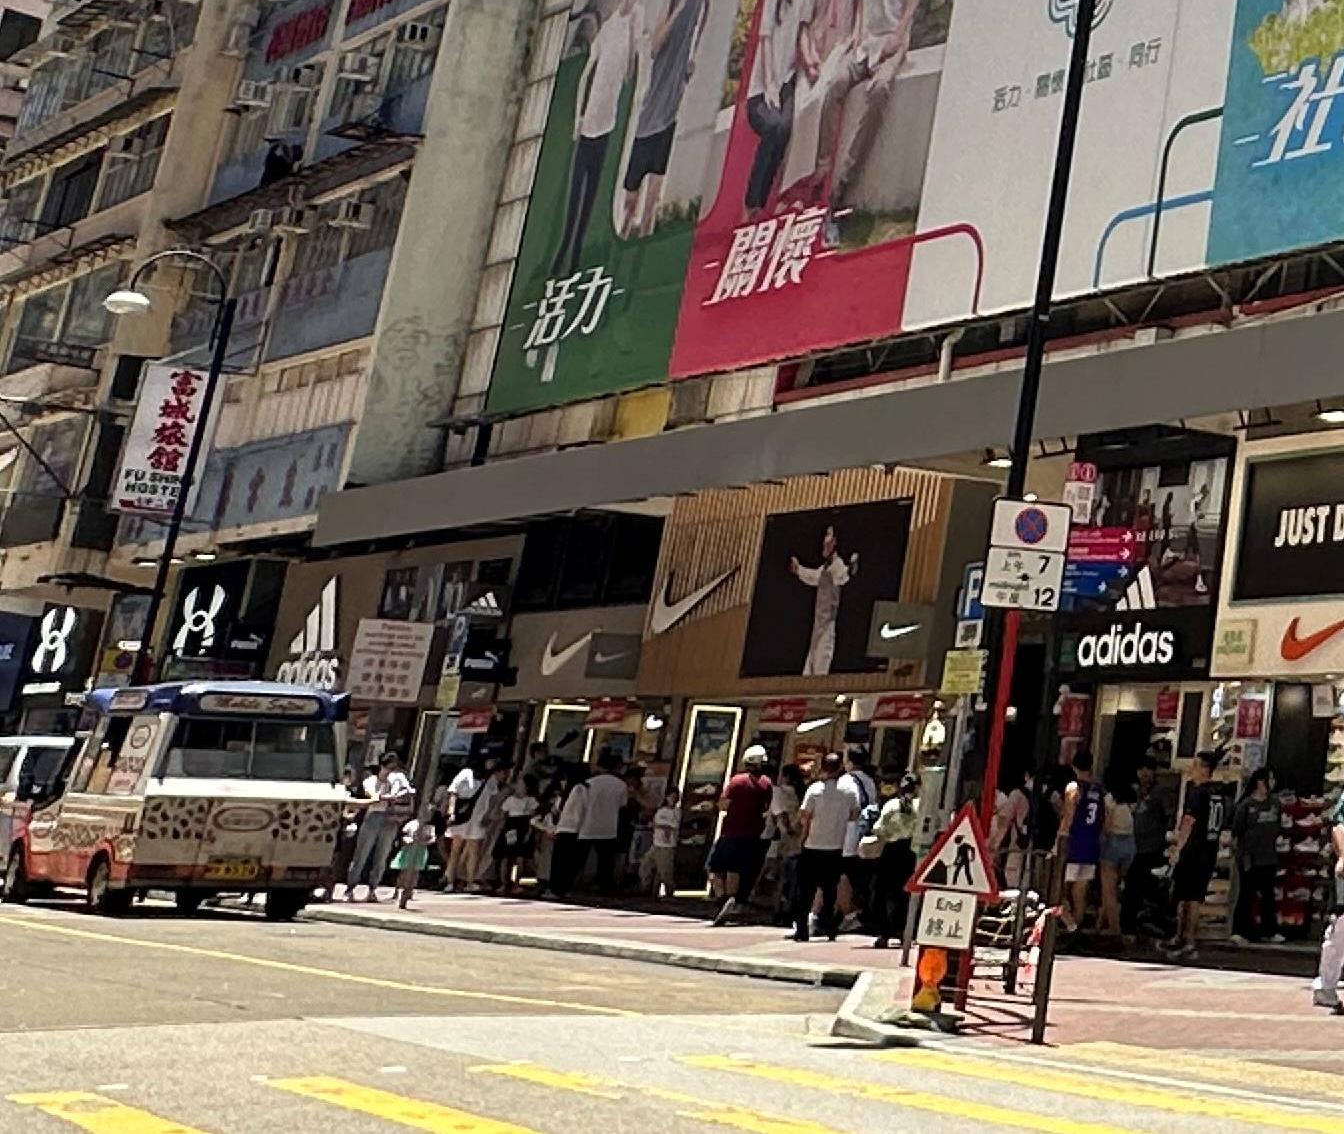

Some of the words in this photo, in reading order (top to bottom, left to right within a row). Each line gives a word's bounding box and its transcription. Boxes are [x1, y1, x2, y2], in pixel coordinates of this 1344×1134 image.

[702, 205, 828, 307] 關懷
[522, 266, 615, 350] 活力
[147, 370, 203, 472] 富城旅館
[124, 467, 147, 482] FU
[124, 483, 180, 498] HOSTE
[1274, 504, 1331, 549] JUST
[1038, 554, 1051, 574] 7
[1034, 587, 1056, 607] 12
[1077, 622, 1175, 667] adidas
[1086, 802, 1098, 825] 3
[936, 897, 963, 913] End
[926, 917, 963, 938] 終止
